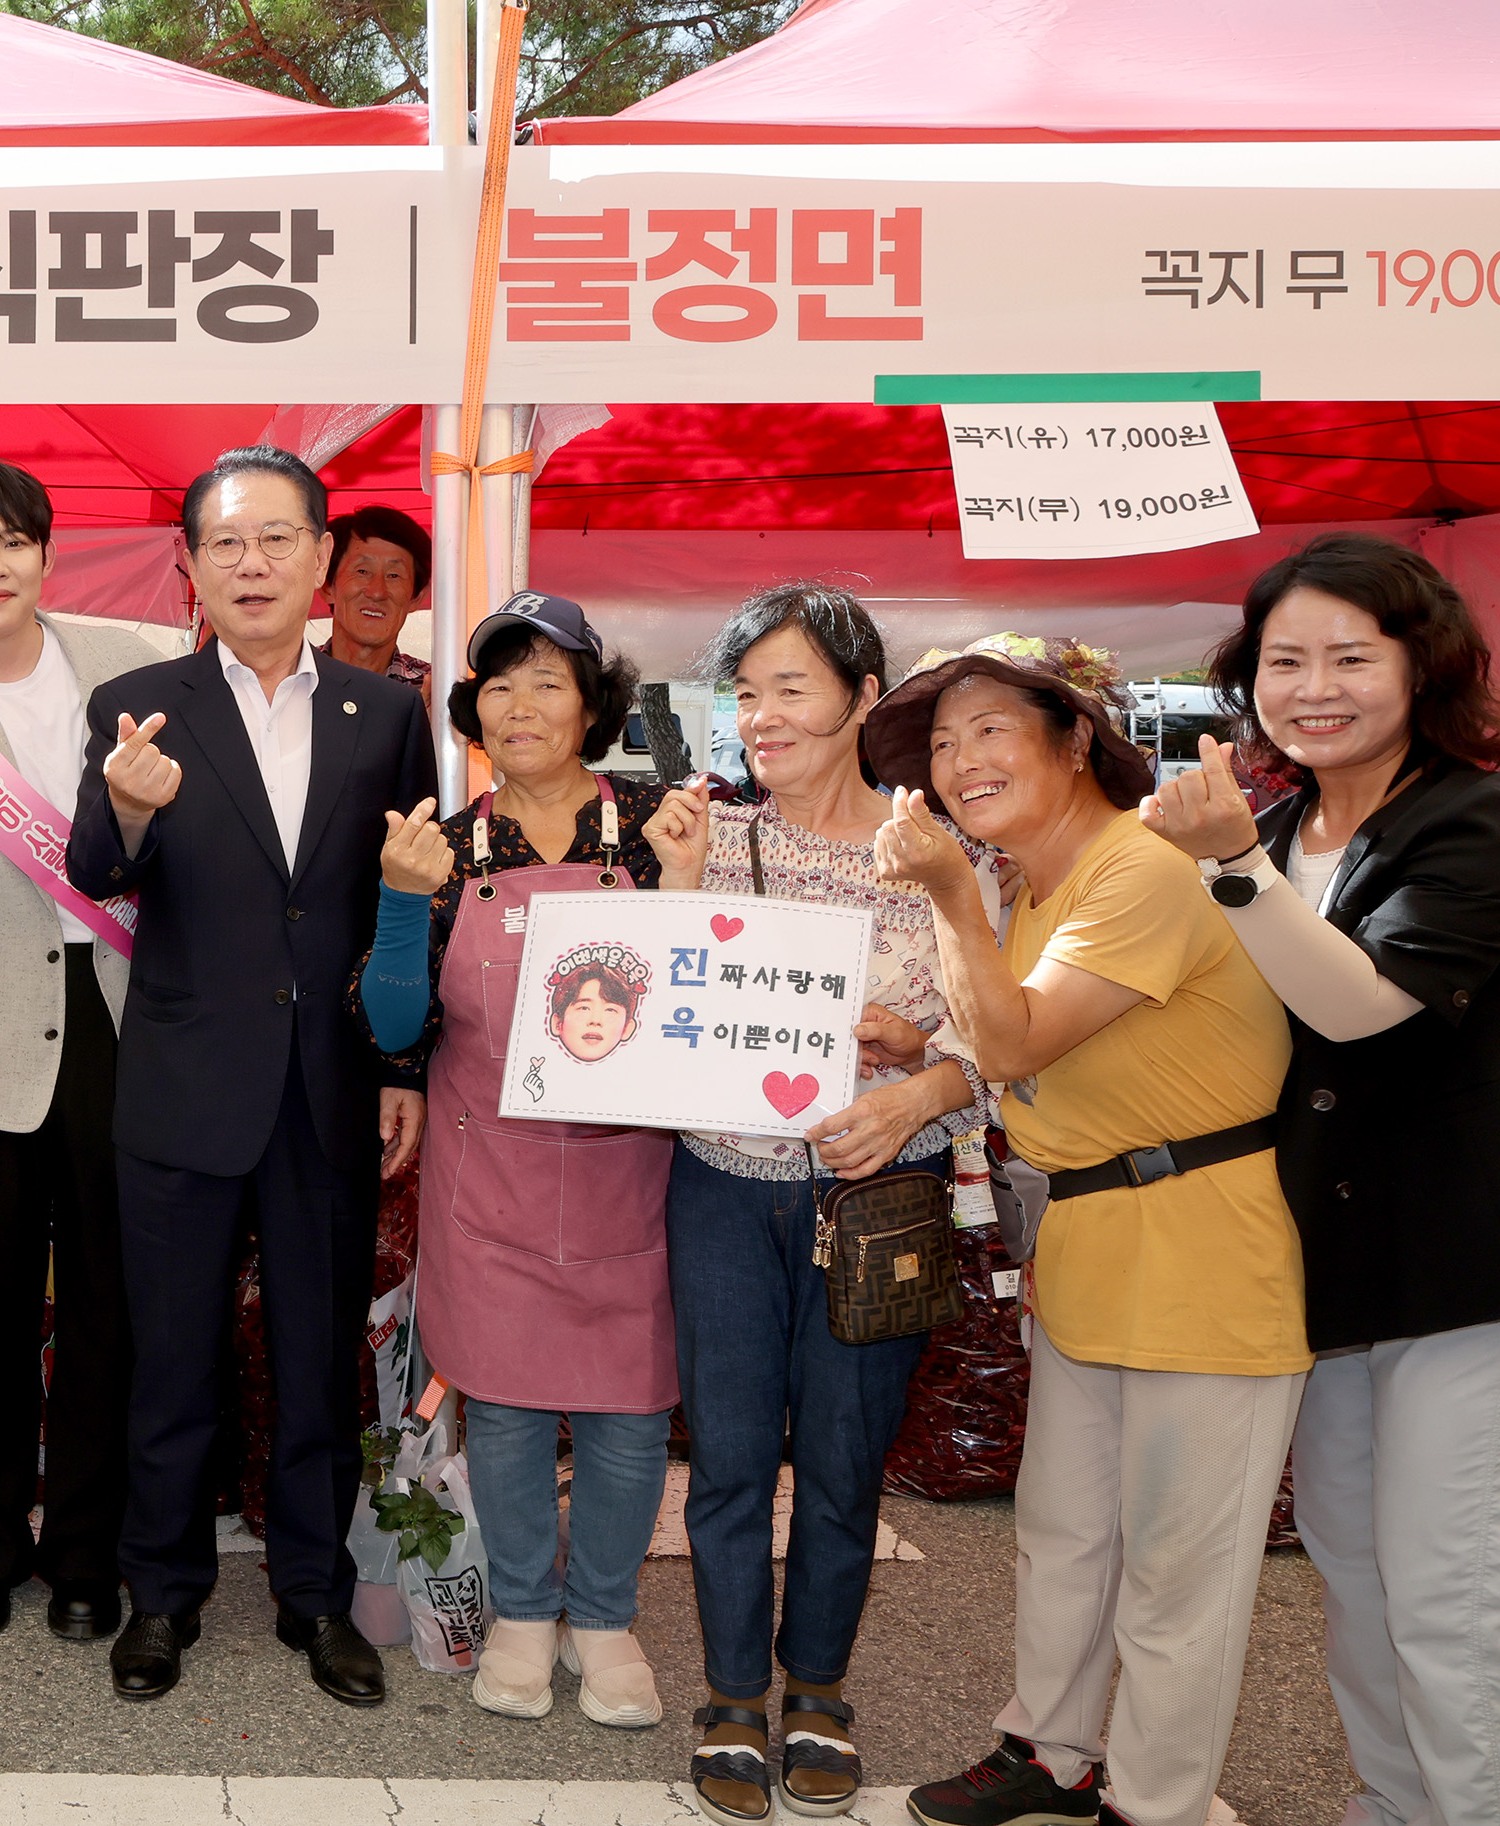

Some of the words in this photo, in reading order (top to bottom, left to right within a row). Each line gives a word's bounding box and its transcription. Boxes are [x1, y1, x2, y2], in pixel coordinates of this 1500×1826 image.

[499, 207, 924, 344] 불정면
[1141, 249, 1264, 310] 꼭지
[1286, 250, 1348, 310] 무
[953, 425, 1069, 449] 꼭지(유)
[1085, 424, 1211, 452] 17,000원
[965, 496, 1080, 522] 꼭지(무)
[1098, 484, 1233, 521] 19,000원
[557, 946, 624, 977] 이번생은
[669, 947, 709, 988] 진
[661, 1006, 704, 1049] 욱
[952, 1139, 987, 1156] 괴산청
[371, 1317, 396, 1348] 괴산
